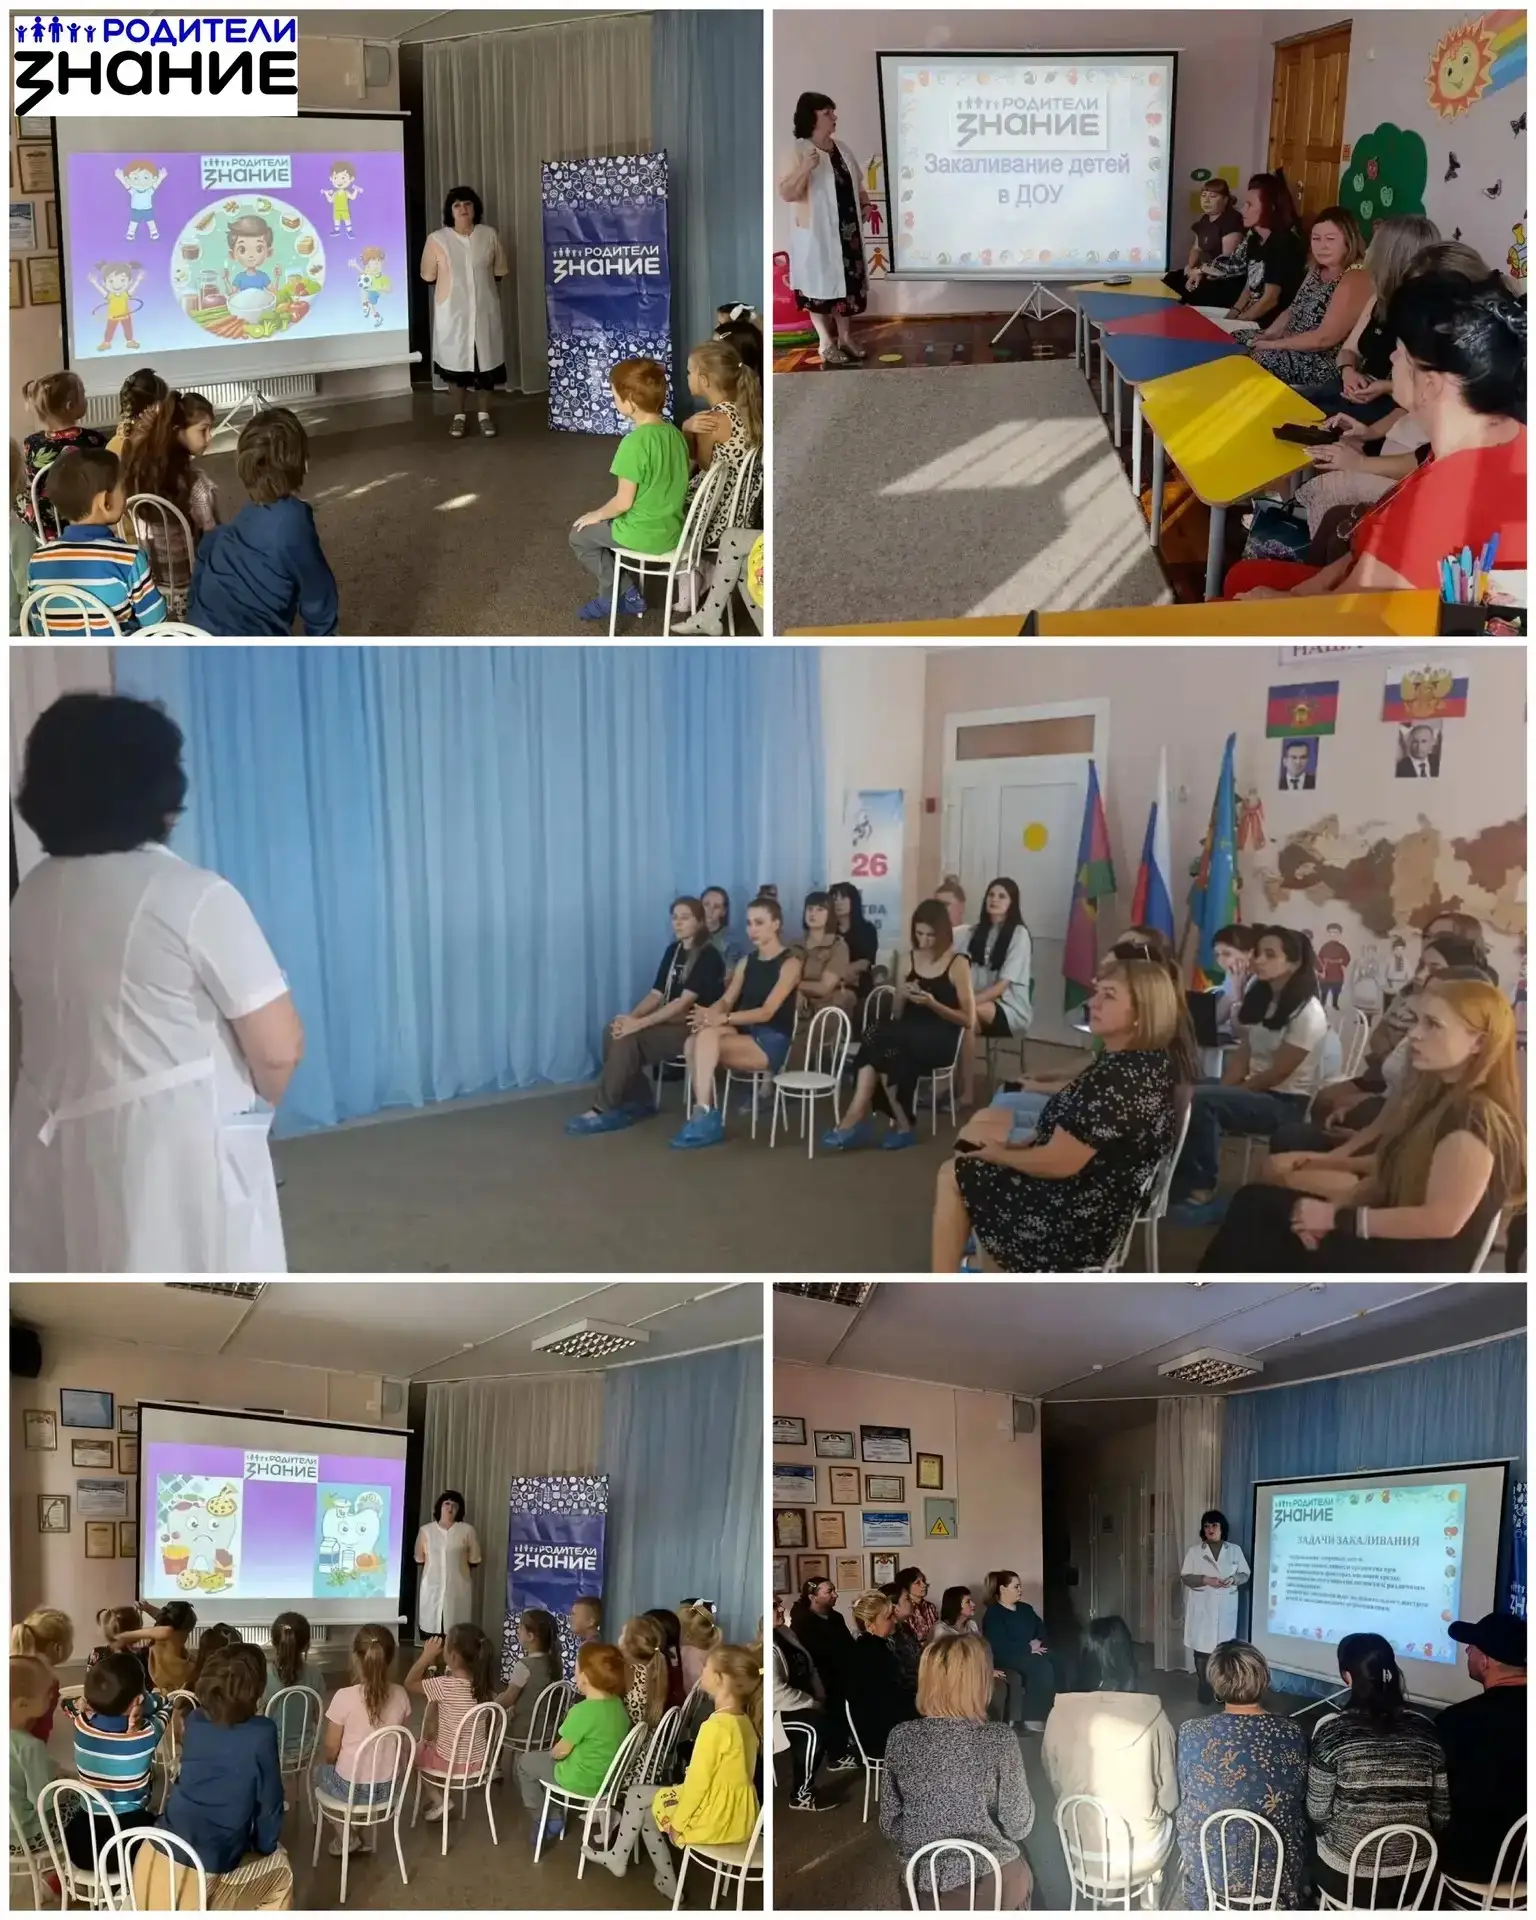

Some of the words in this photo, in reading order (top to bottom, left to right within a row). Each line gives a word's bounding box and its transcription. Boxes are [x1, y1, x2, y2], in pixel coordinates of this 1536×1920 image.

[1002, 97, 1099, 111] РОДИТЕЛИ
[231, 158, 289, 167] РОДИТЕЛИ
[924, 153, 1064, 174] Закаливание
[1069, 153, 1130, 178] детей
[998, 189, 1010, 204] в
[1015, 185, 1064, 207] ДОУ
[584, 245, 659, 257] РОДИТЕЛИ
[851, 852, 889, 877] 26
